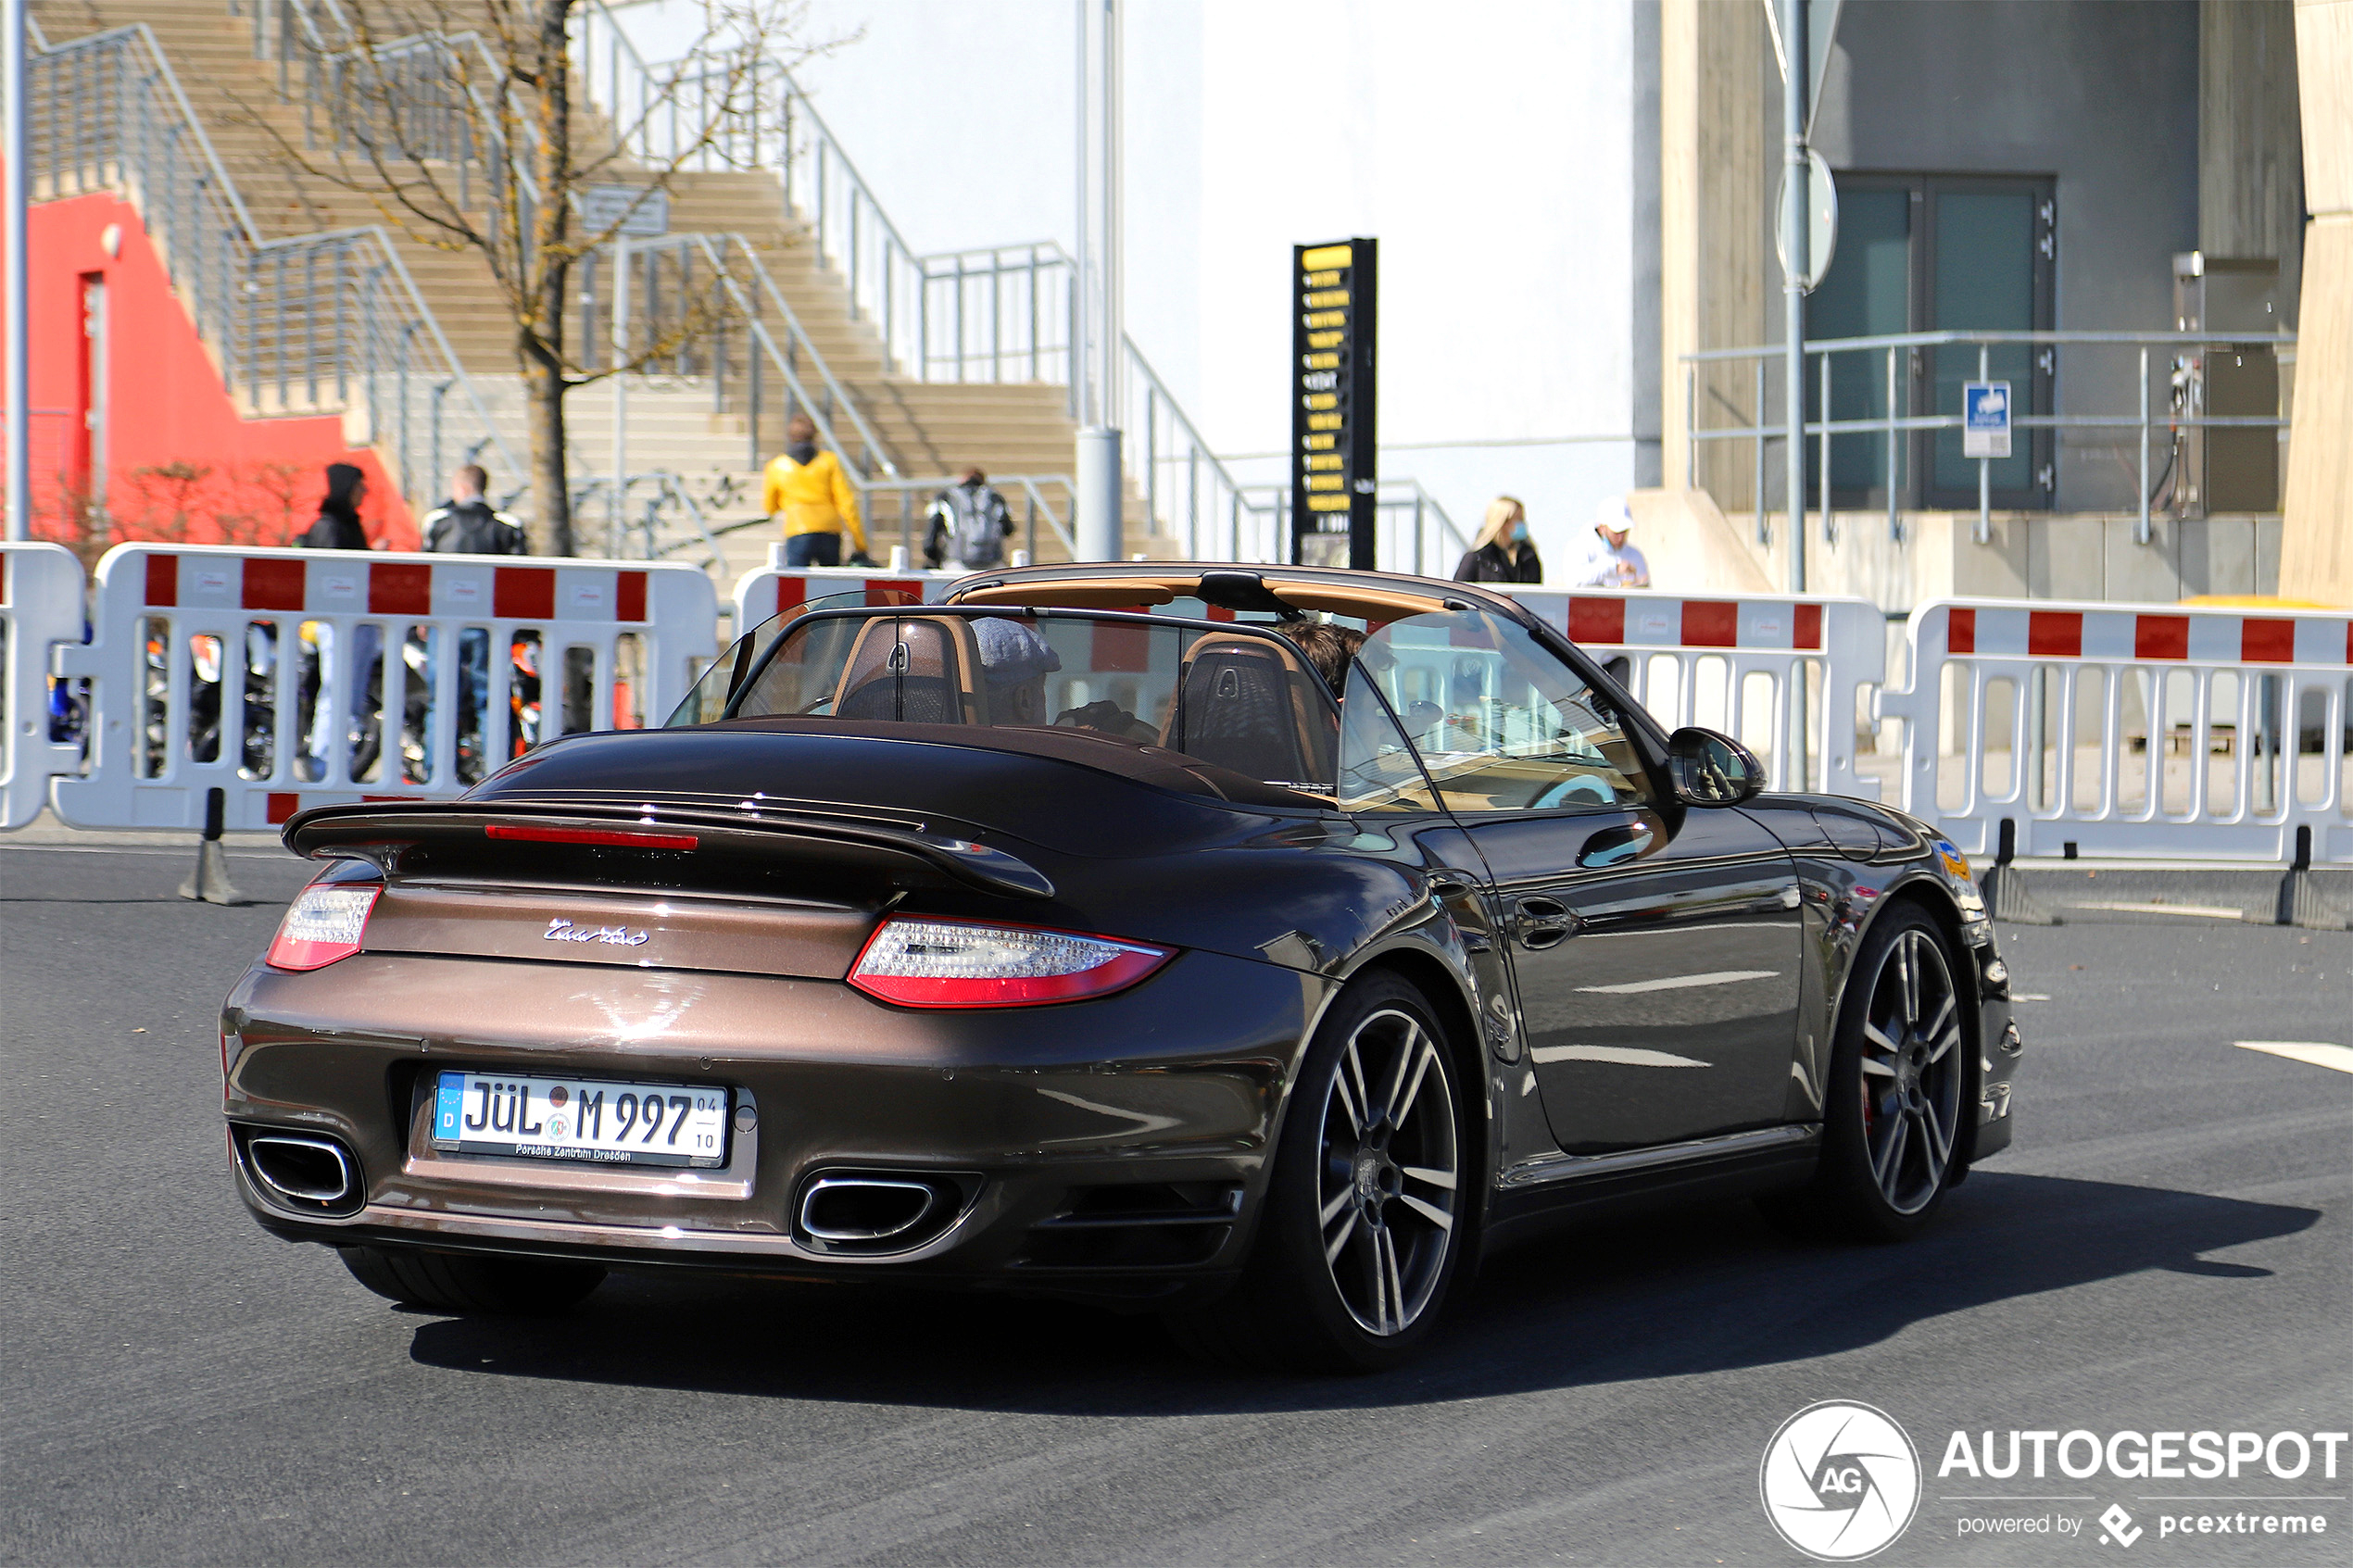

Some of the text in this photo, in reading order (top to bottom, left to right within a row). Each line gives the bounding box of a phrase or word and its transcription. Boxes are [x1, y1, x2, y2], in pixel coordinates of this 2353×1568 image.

[698, 1098, 716, 1111] 04
[443, 1112, 455, 1128] D
[465, 1082, 542, 1135] JÜL
[576, 1089, 604, 1140] M
[615, 1093, 692, 1146] 997
[697, 1134, 713, 1148] 10
[515, 1143, 631, 1161] Porsche Zentrum Dresden
